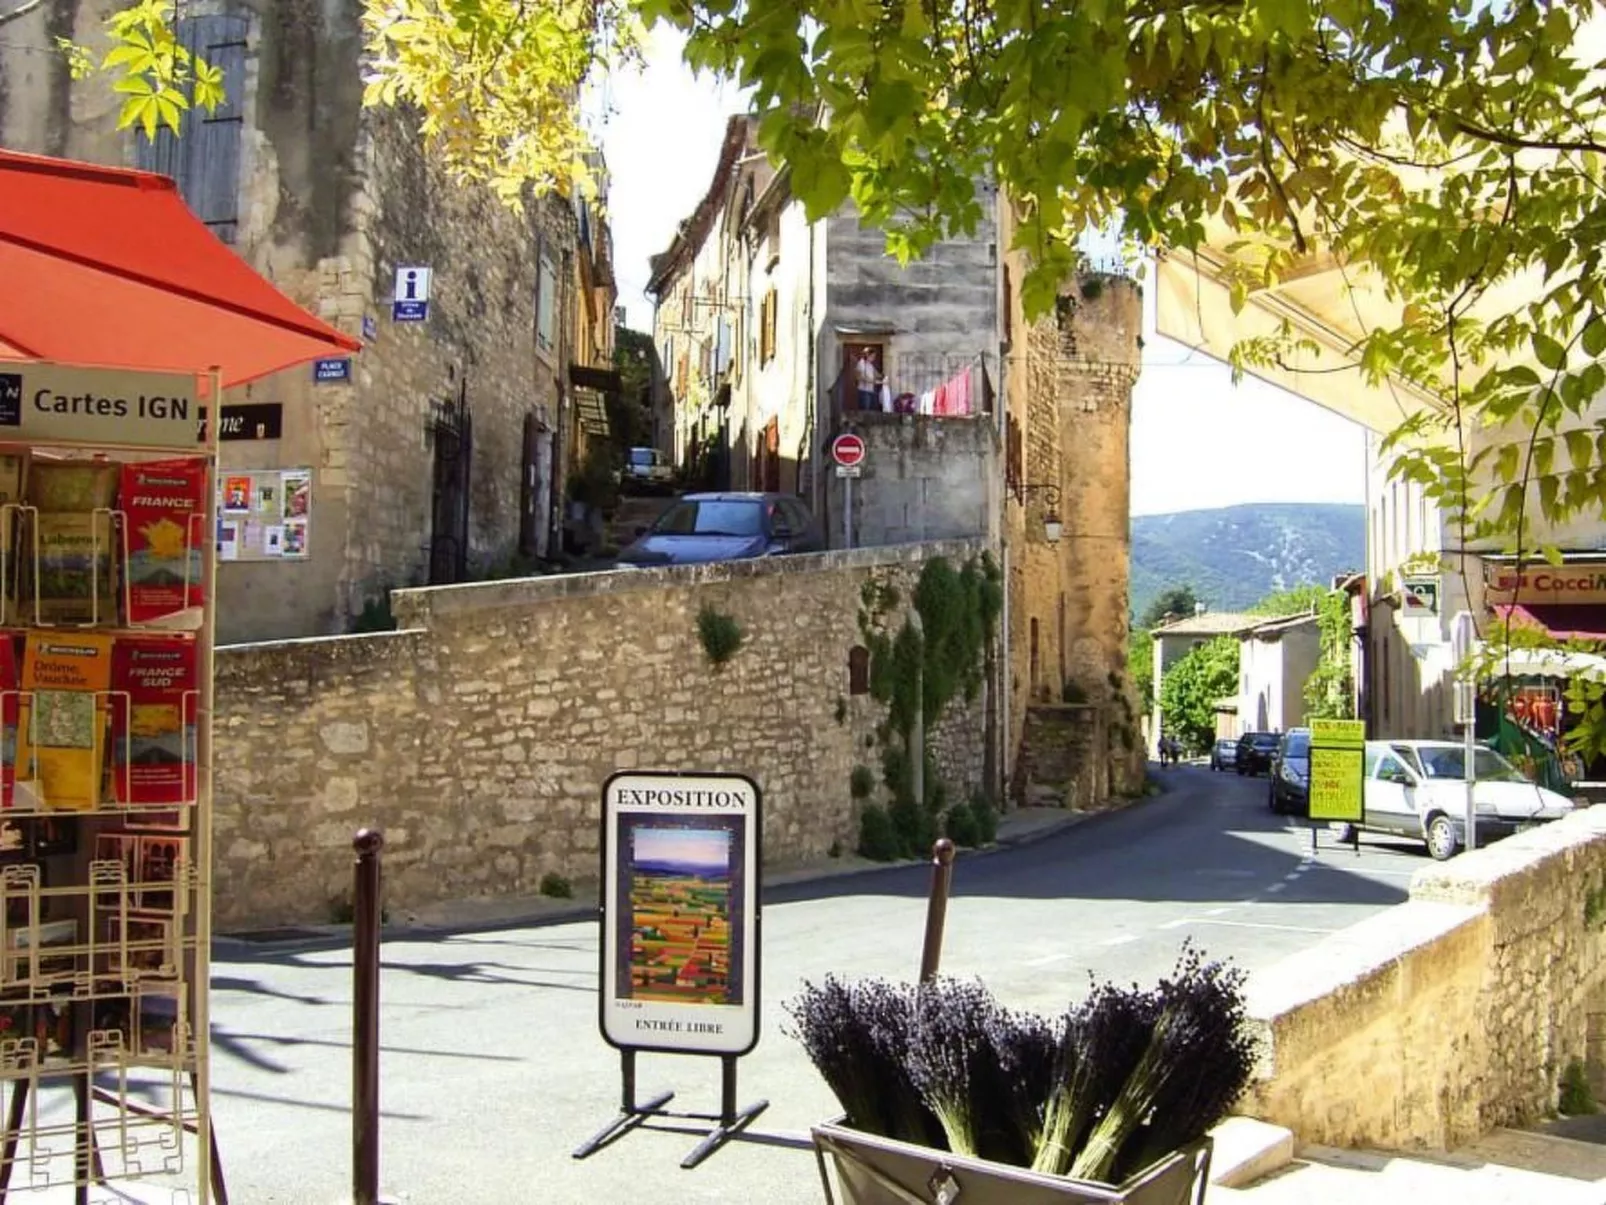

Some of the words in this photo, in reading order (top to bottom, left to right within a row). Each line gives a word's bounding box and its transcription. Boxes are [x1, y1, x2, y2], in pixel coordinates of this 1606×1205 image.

[34, 388, 128, 417] Cartes
[139, 396, 188, 420] IGN
[132, 496, 196, 508] FRANCE
[128, 667, 187, 678] FRANCE
[142, 677, 172, 688] SUD
[617, 788, 746, 808] EXPOSITION
[635, 1018, 682, 1032] ENTRÉE
[687, 1022, 724, 1034] LIBRE
